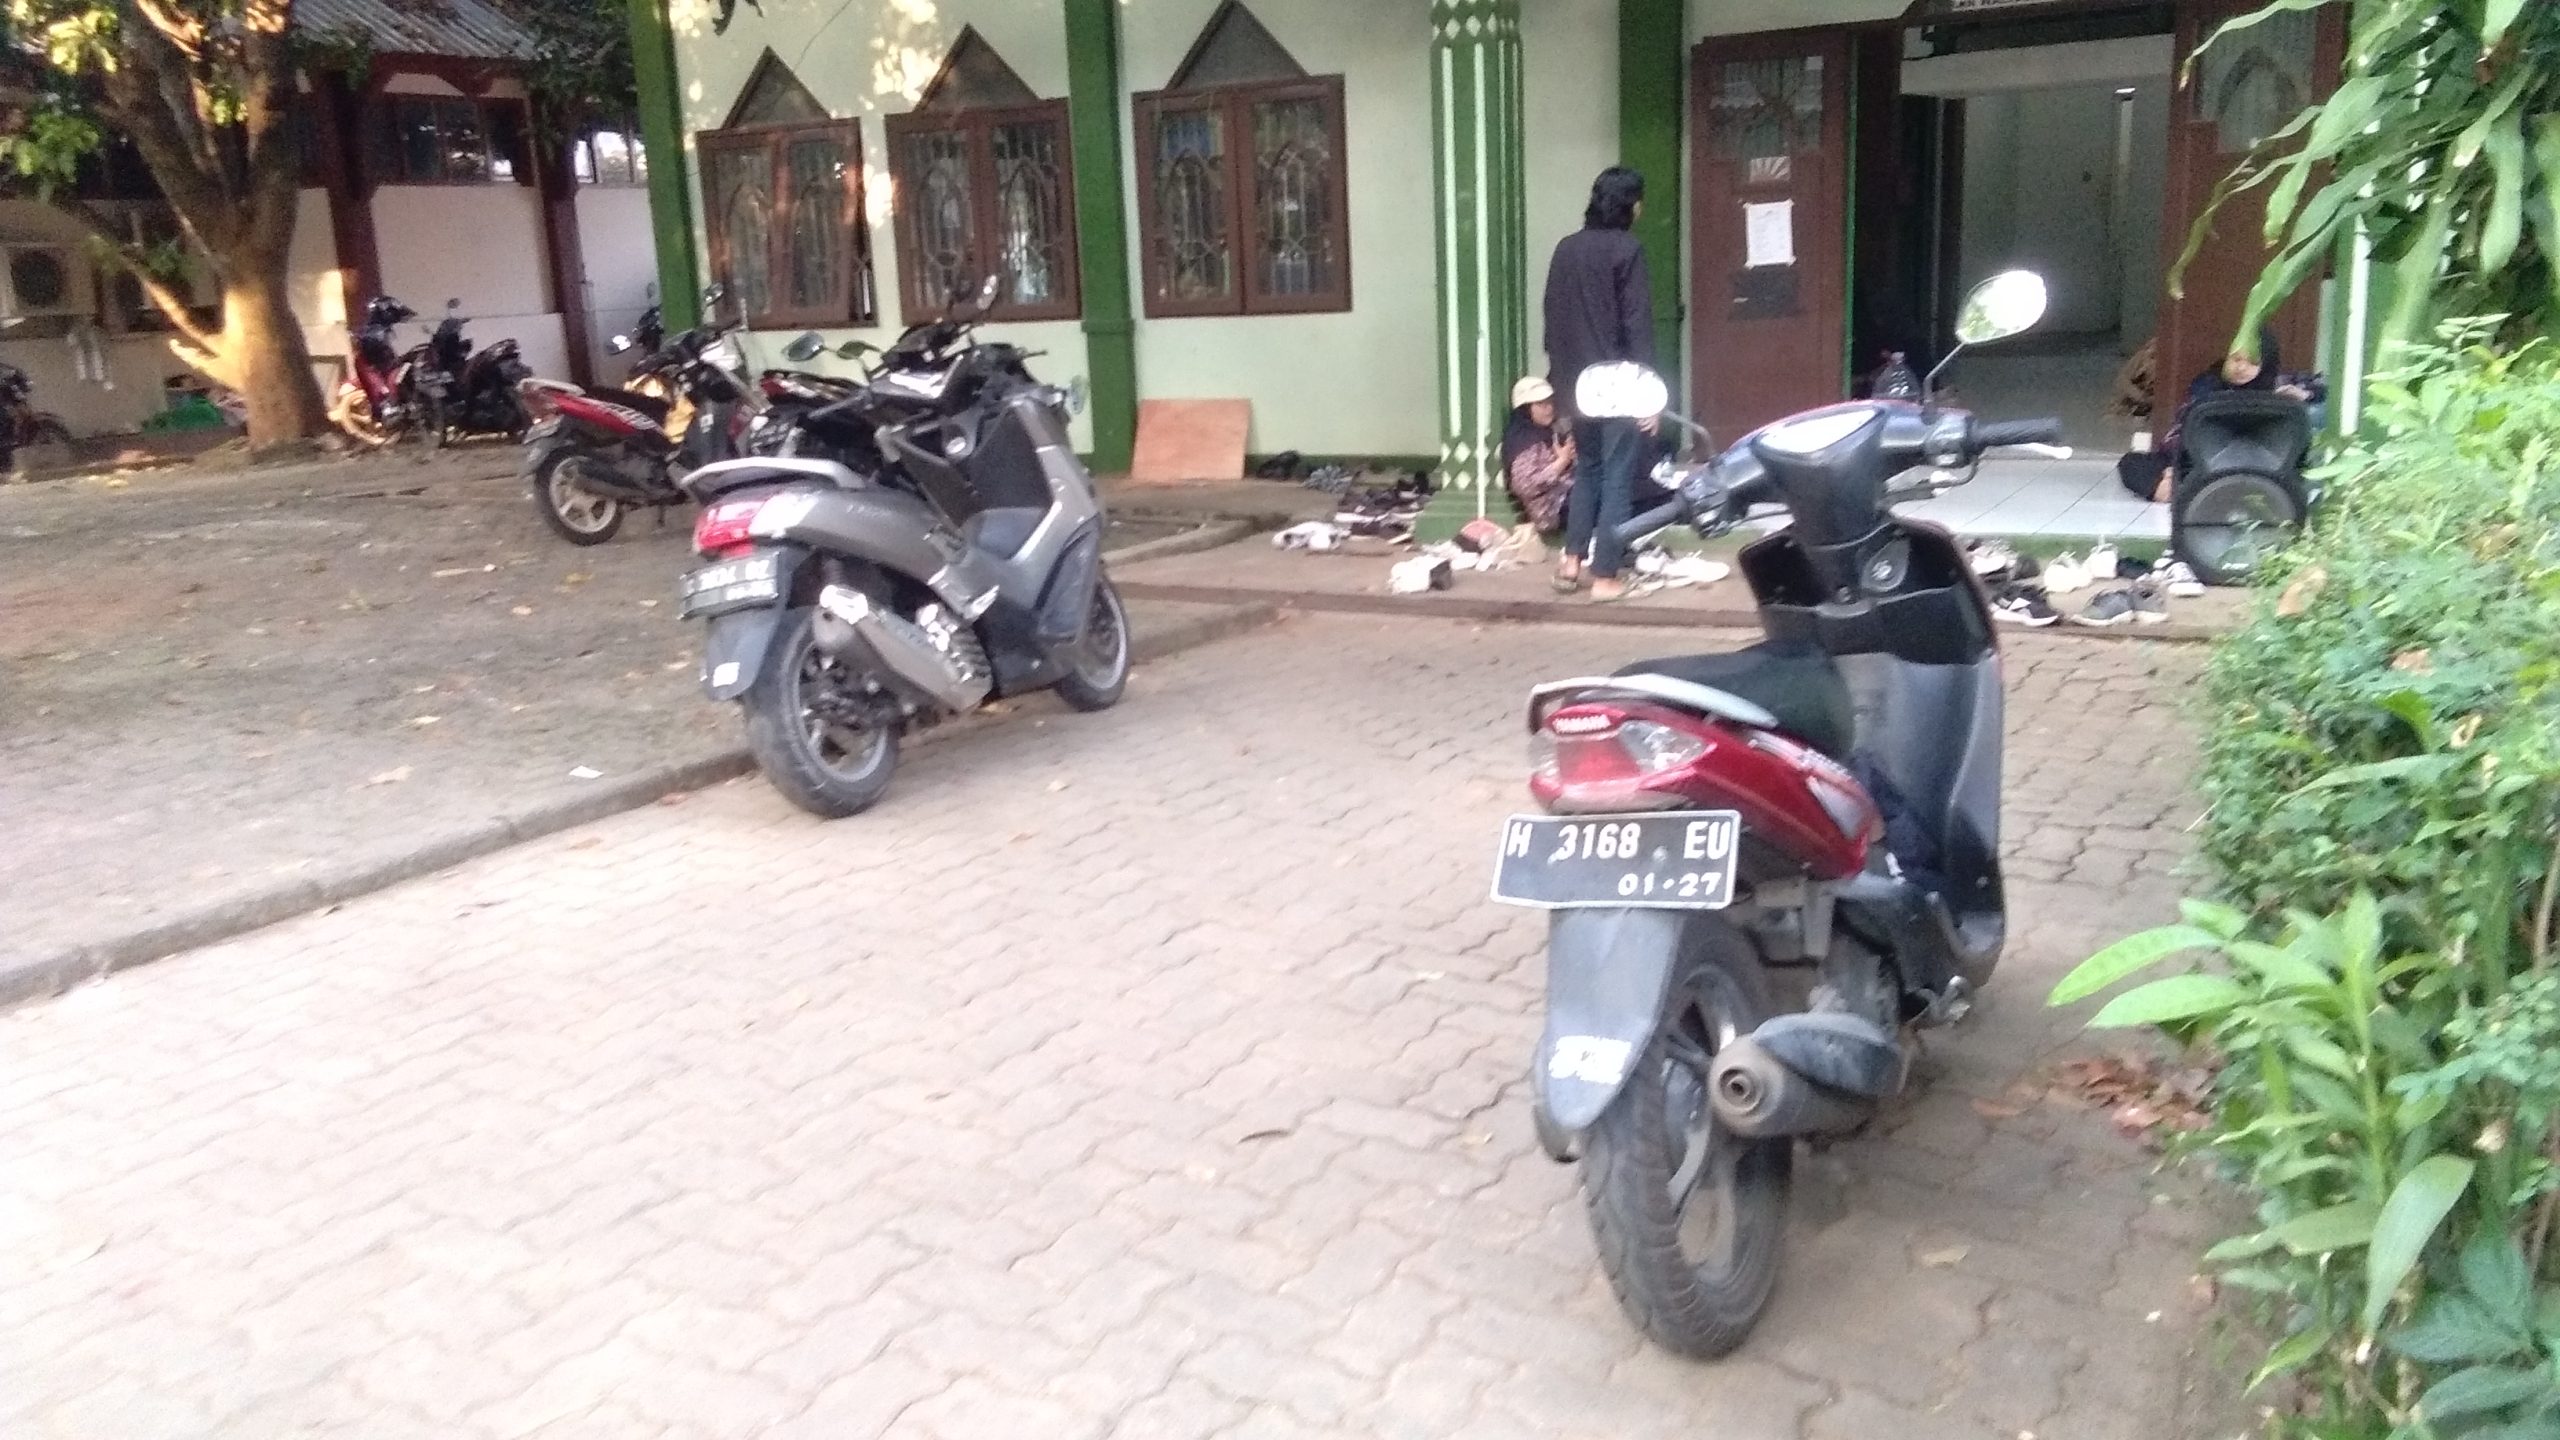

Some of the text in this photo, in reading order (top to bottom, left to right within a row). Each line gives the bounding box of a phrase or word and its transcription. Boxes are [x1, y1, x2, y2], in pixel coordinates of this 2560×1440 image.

[1507, 821, 1731, 861] H 3168 EU
